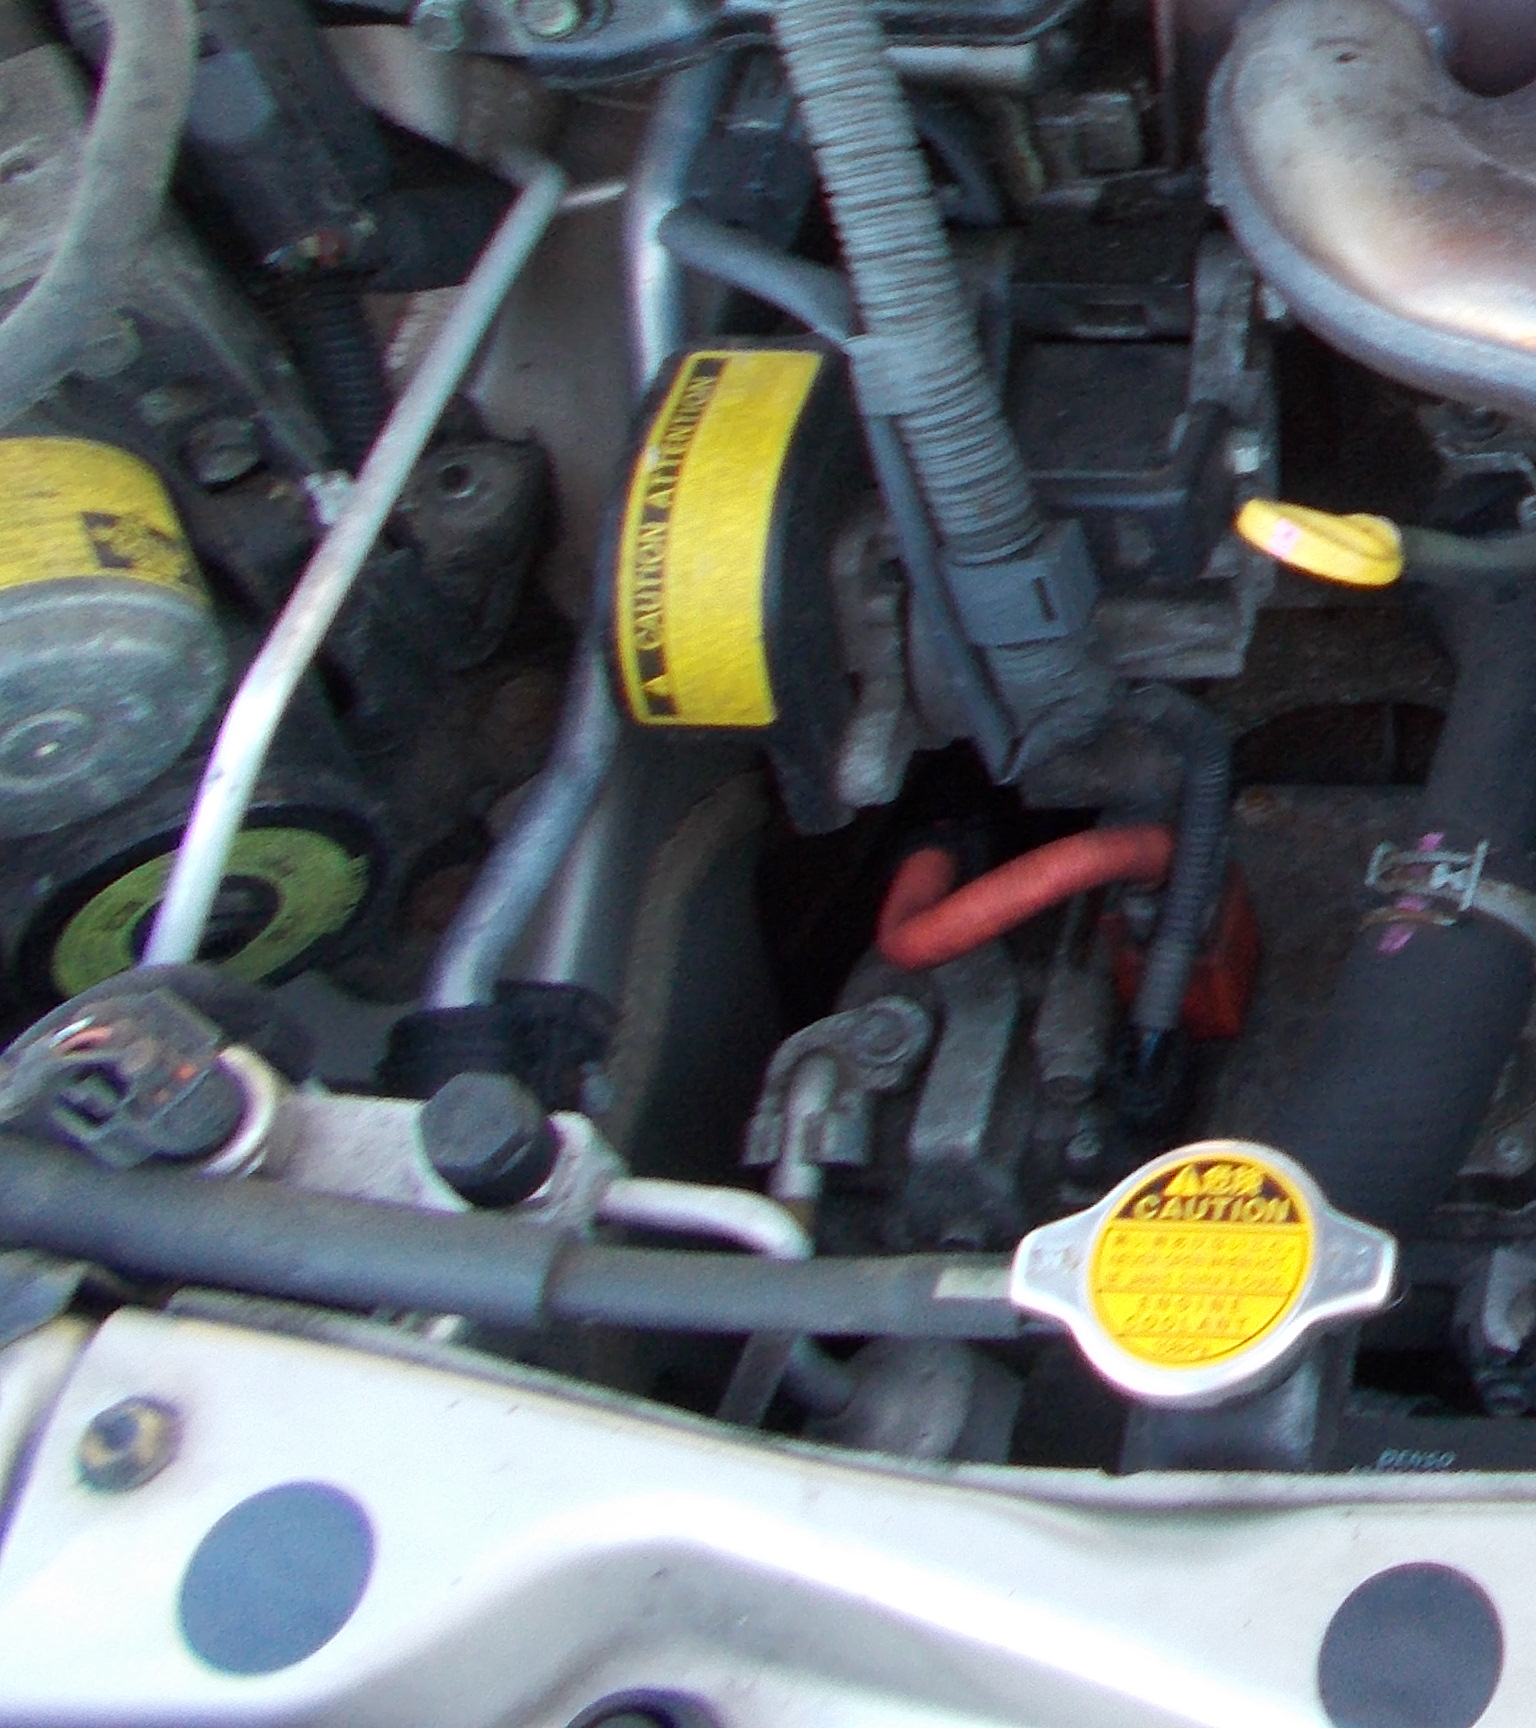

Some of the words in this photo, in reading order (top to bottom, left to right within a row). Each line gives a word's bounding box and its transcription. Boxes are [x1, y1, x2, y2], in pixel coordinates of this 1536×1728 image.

[645, 374, 714, 510] ATTENTION
[634, 520, 668, 652] CAUTION
[1132, 1193, 1291, 1223] CAUTION
